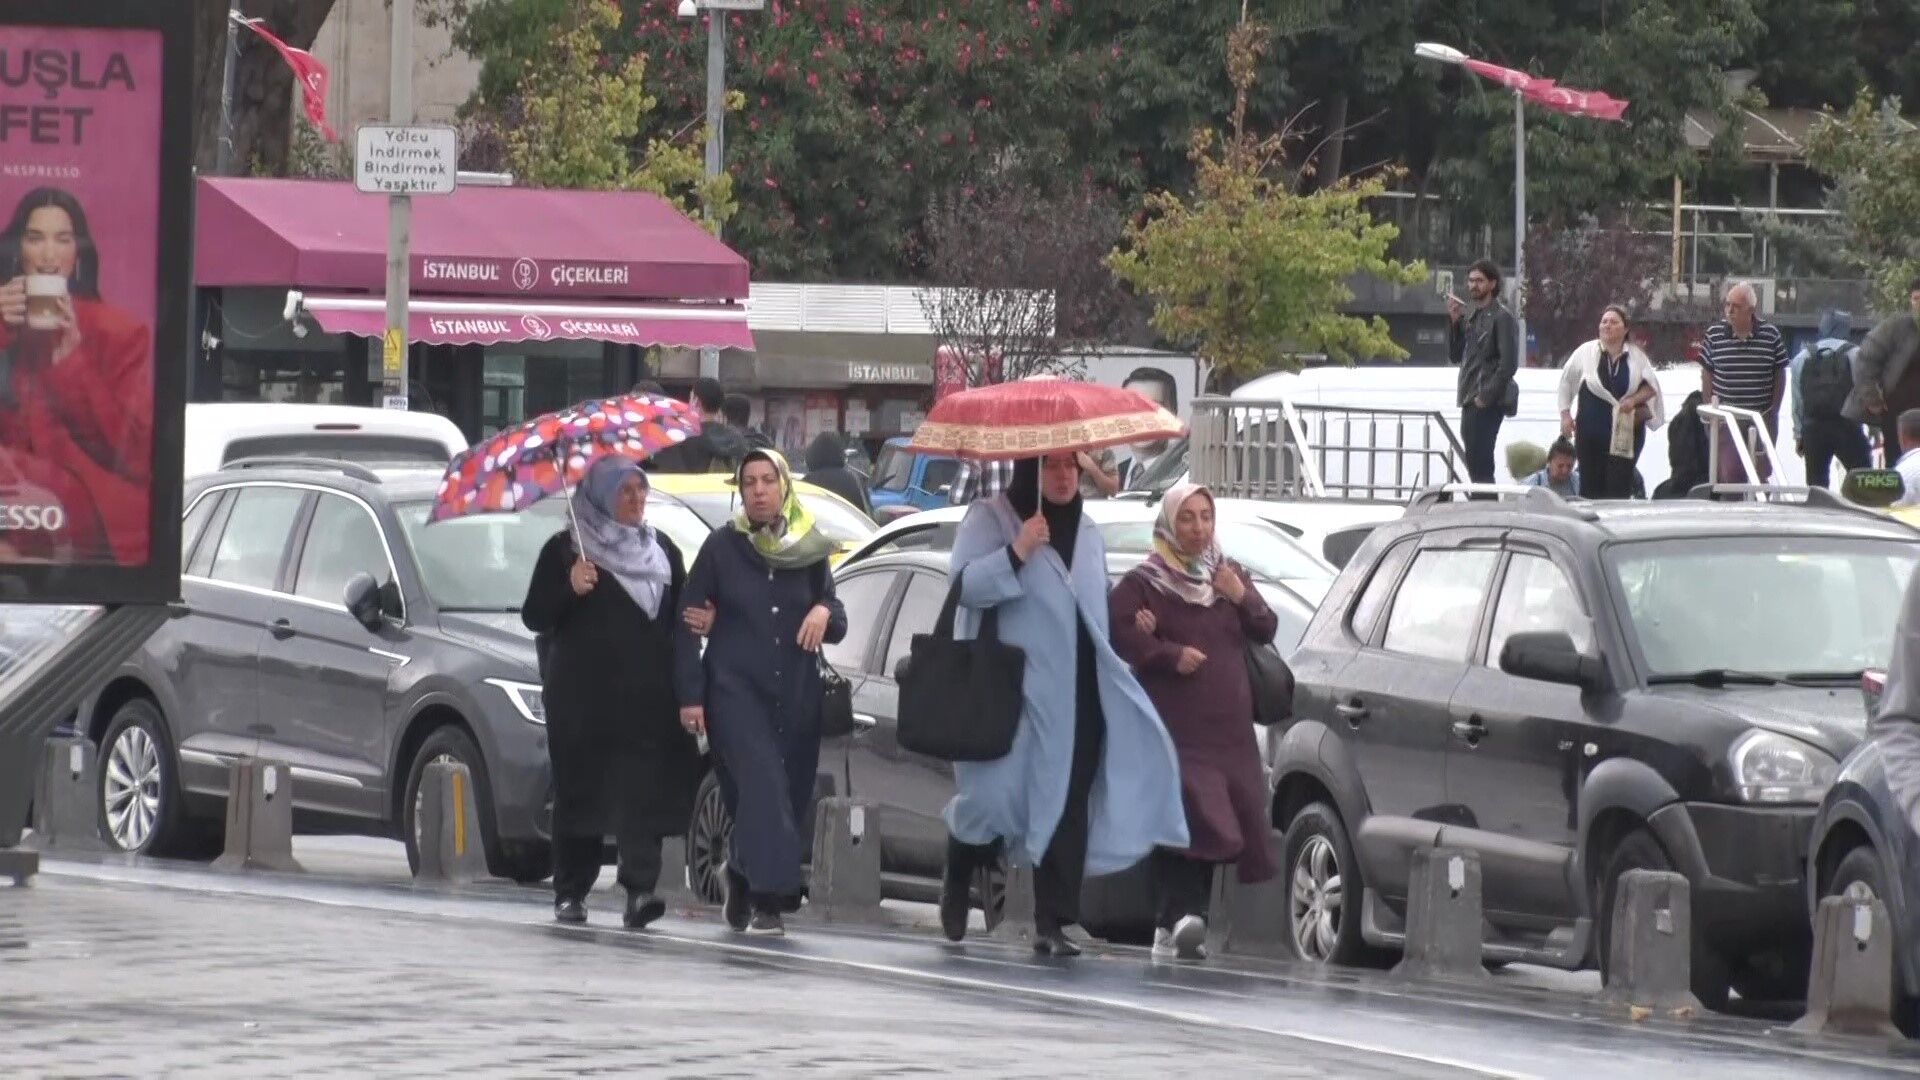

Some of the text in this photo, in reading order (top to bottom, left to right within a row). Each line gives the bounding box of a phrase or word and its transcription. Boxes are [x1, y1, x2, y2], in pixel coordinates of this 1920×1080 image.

[385, 130, 428, 142] Yolcu
[365, 161, 445, 174] Bindirmek
[375, 177, 437, 190] Yasaktır
[551, 264, 629, 286] ÇİÇEKLERİ
[560, 318, 640, 337] ÇİÇEKLERİ
[848, 360, 920, 380] İSTANBUL
